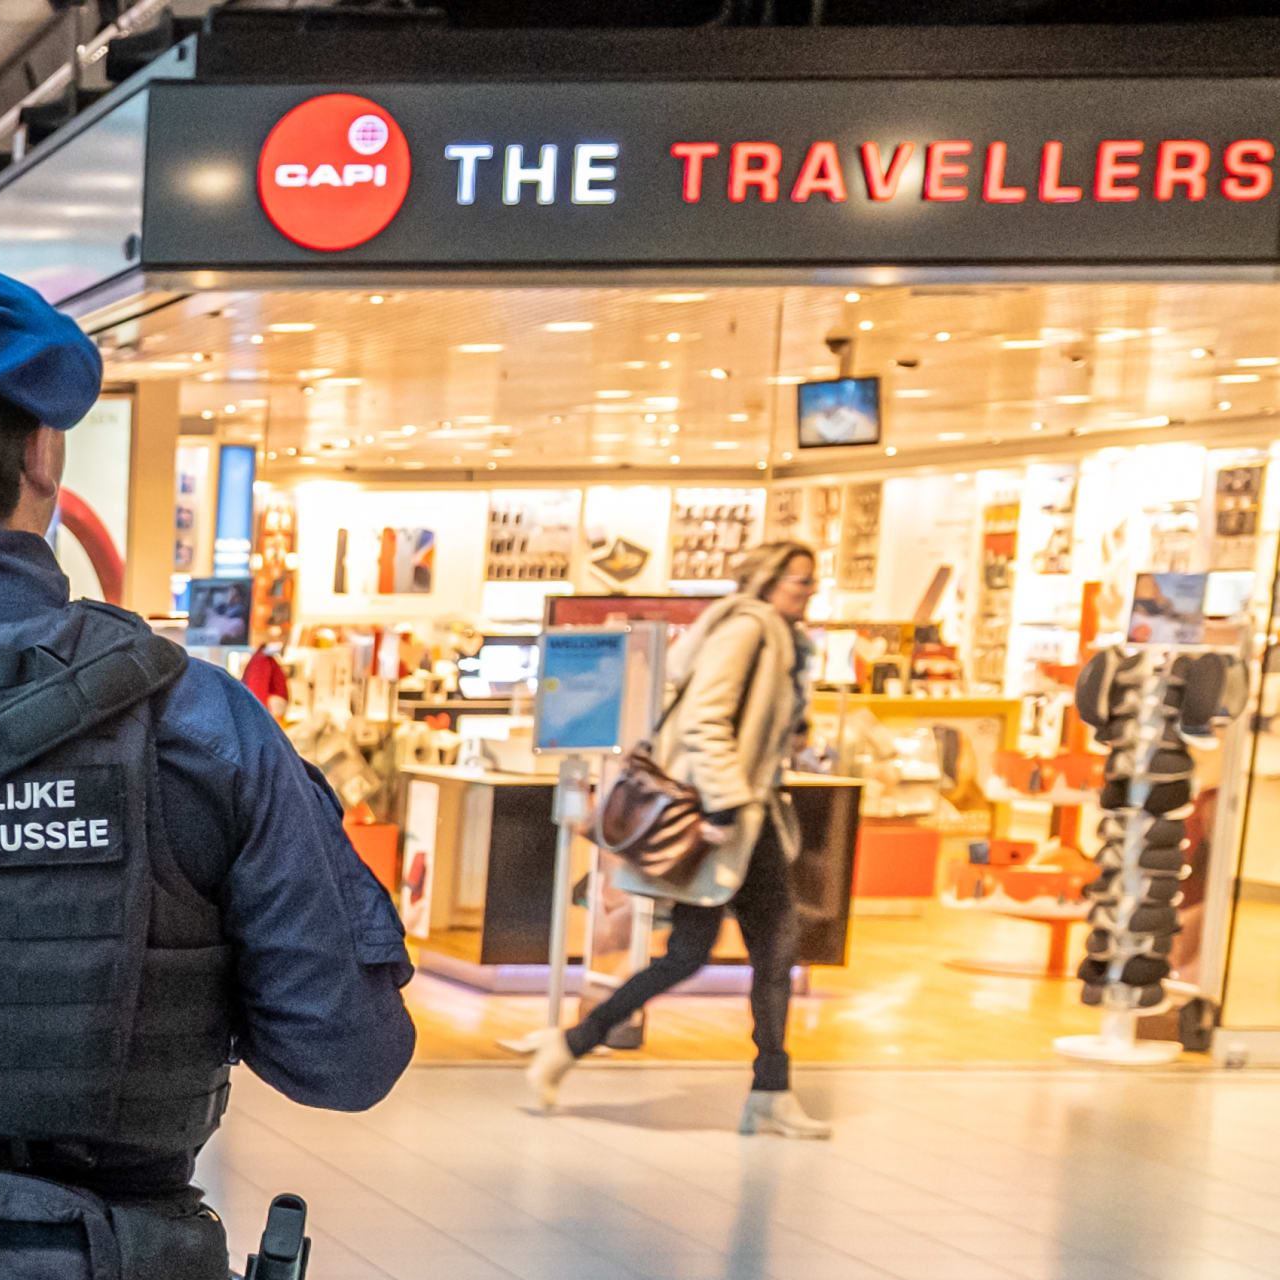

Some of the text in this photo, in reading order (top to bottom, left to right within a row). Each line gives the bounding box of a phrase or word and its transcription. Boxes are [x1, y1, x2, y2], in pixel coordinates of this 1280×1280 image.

[275, 163, 388, 188] CAPI
[444, 139, 1276, 205] THE TRAVELLERS
